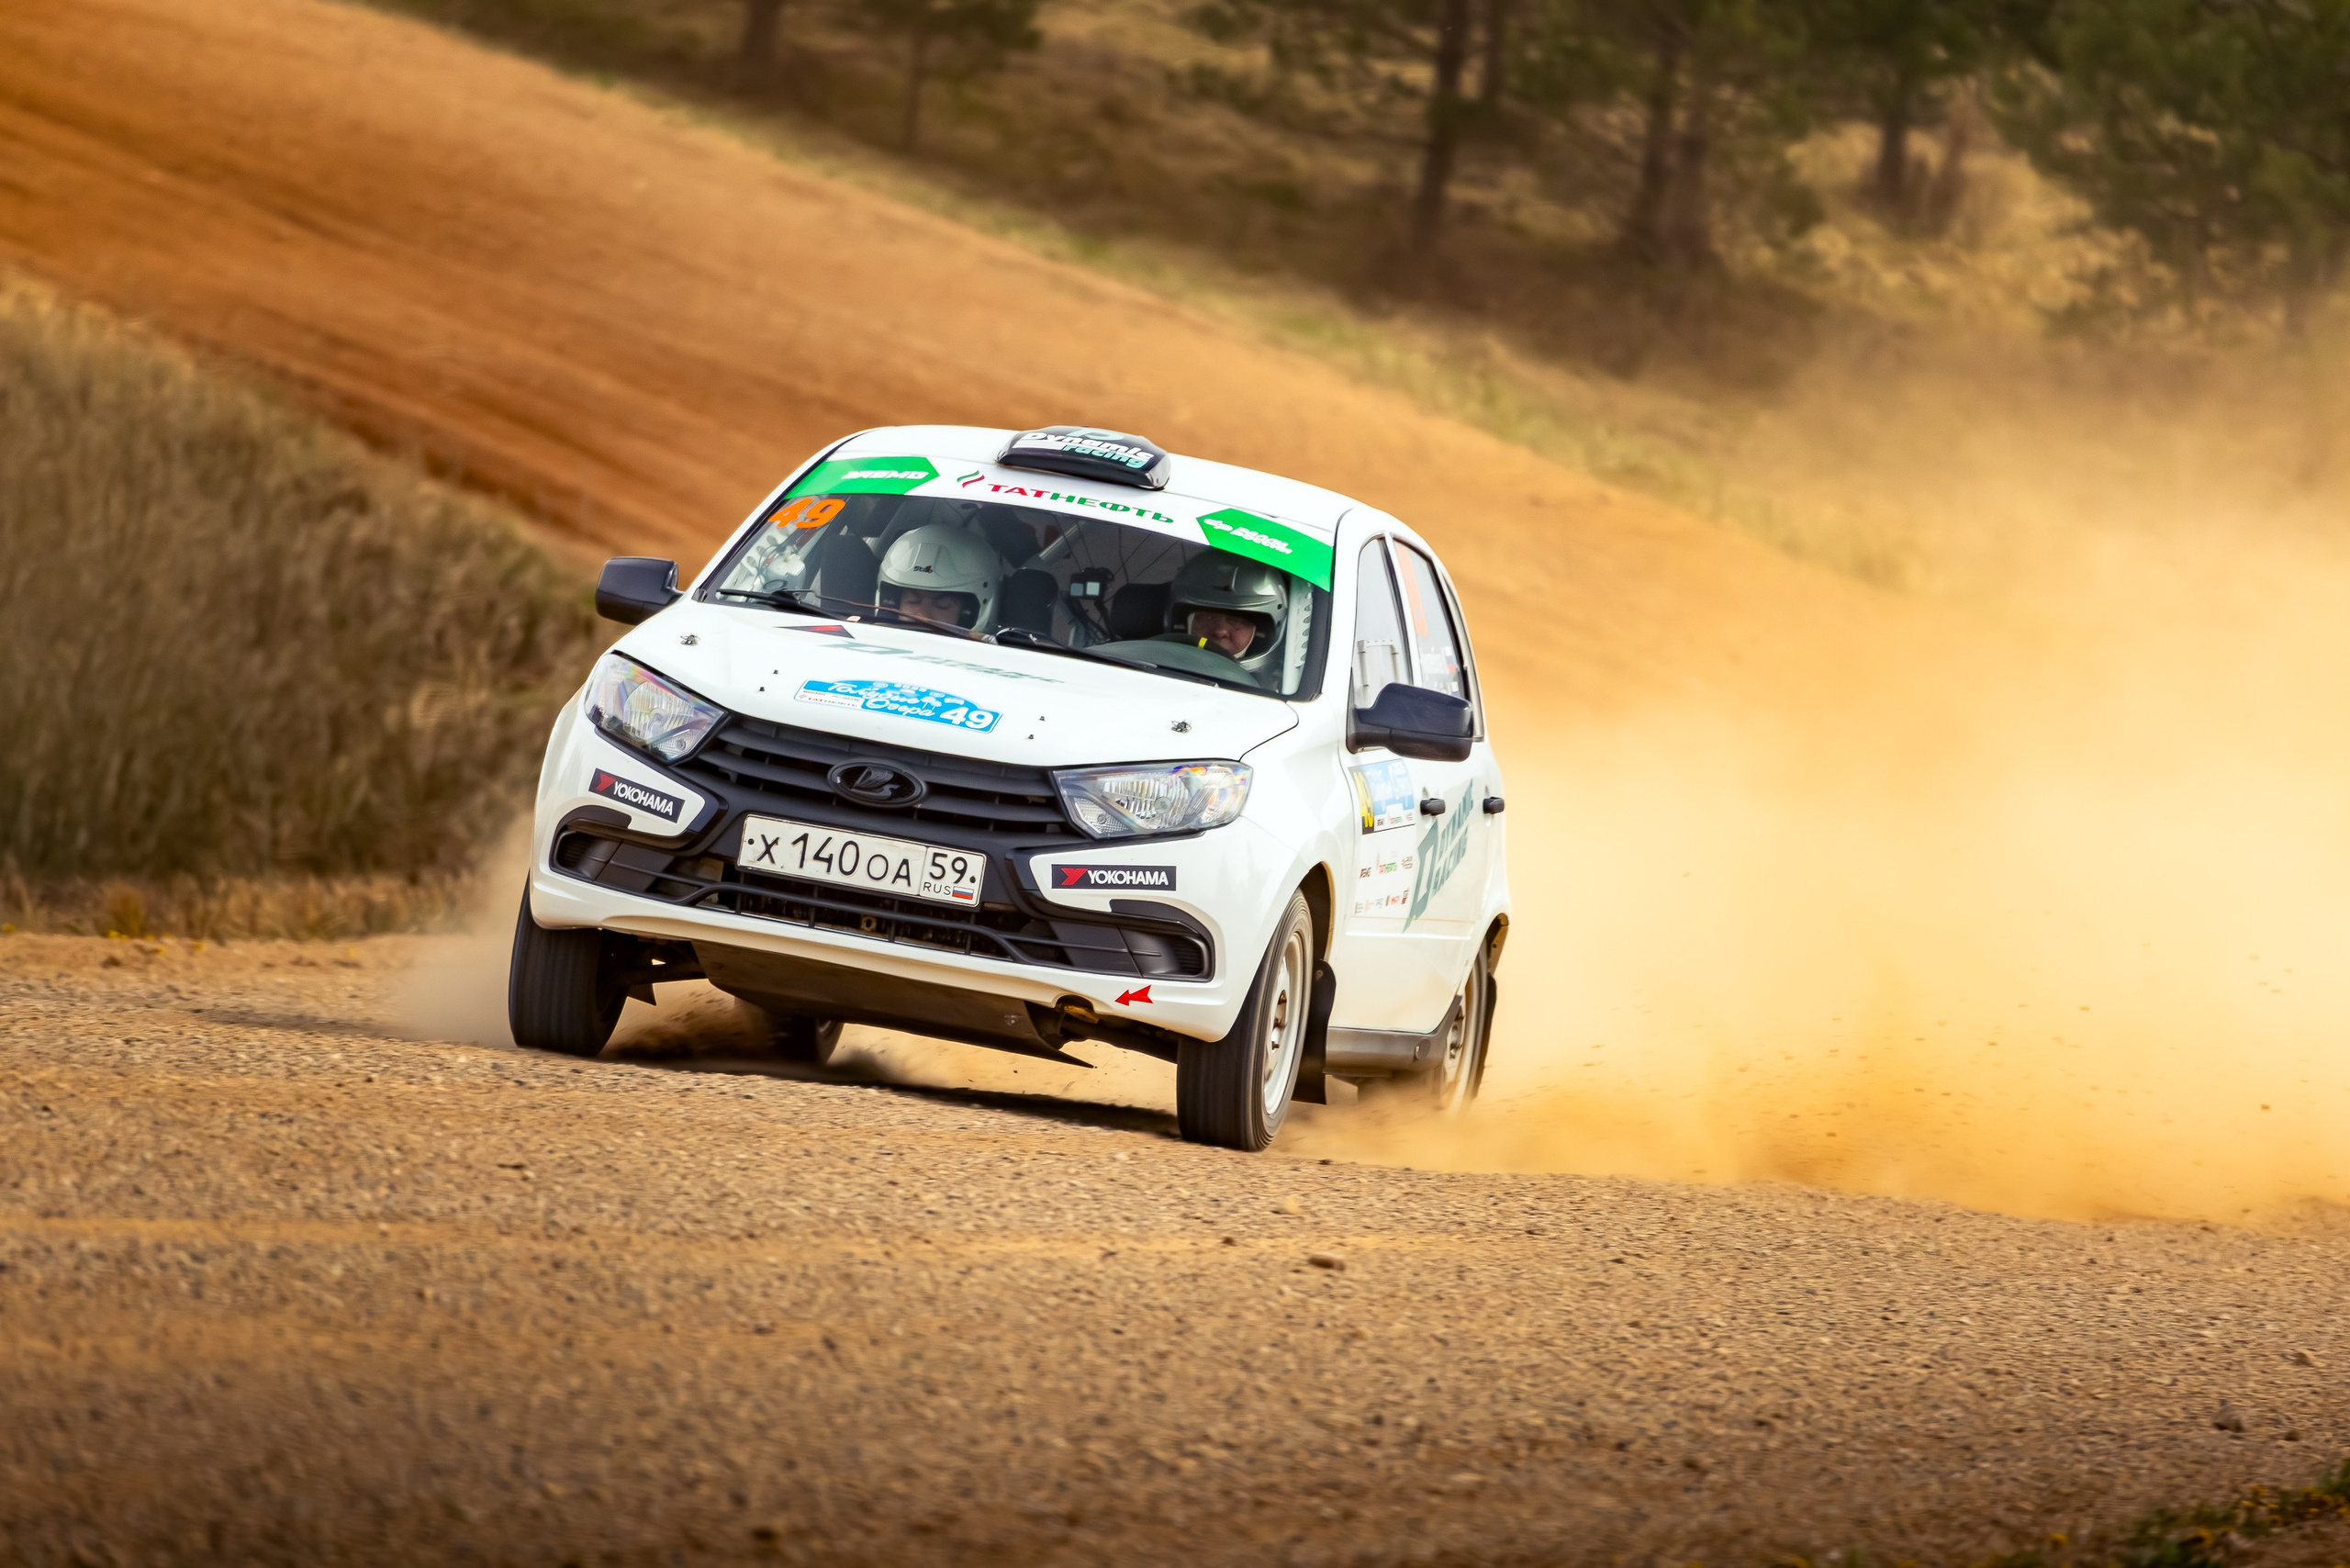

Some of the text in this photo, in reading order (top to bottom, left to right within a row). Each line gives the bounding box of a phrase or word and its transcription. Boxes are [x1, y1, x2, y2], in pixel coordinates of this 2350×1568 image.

[1062, 444, 1148, 469] racing
[767, 498, 846, 529] 49
[988, 484, 1175, 523] ТАТНЕФТЬ
[939, 707, 995, 730] 49
[613, 780, 674, 816] YOKOHAMA
[929, 852, 968, 885] 59
[1087, 869, 1169, 886] YOKOHAMA
[923, 881, 952, 896] RUS
